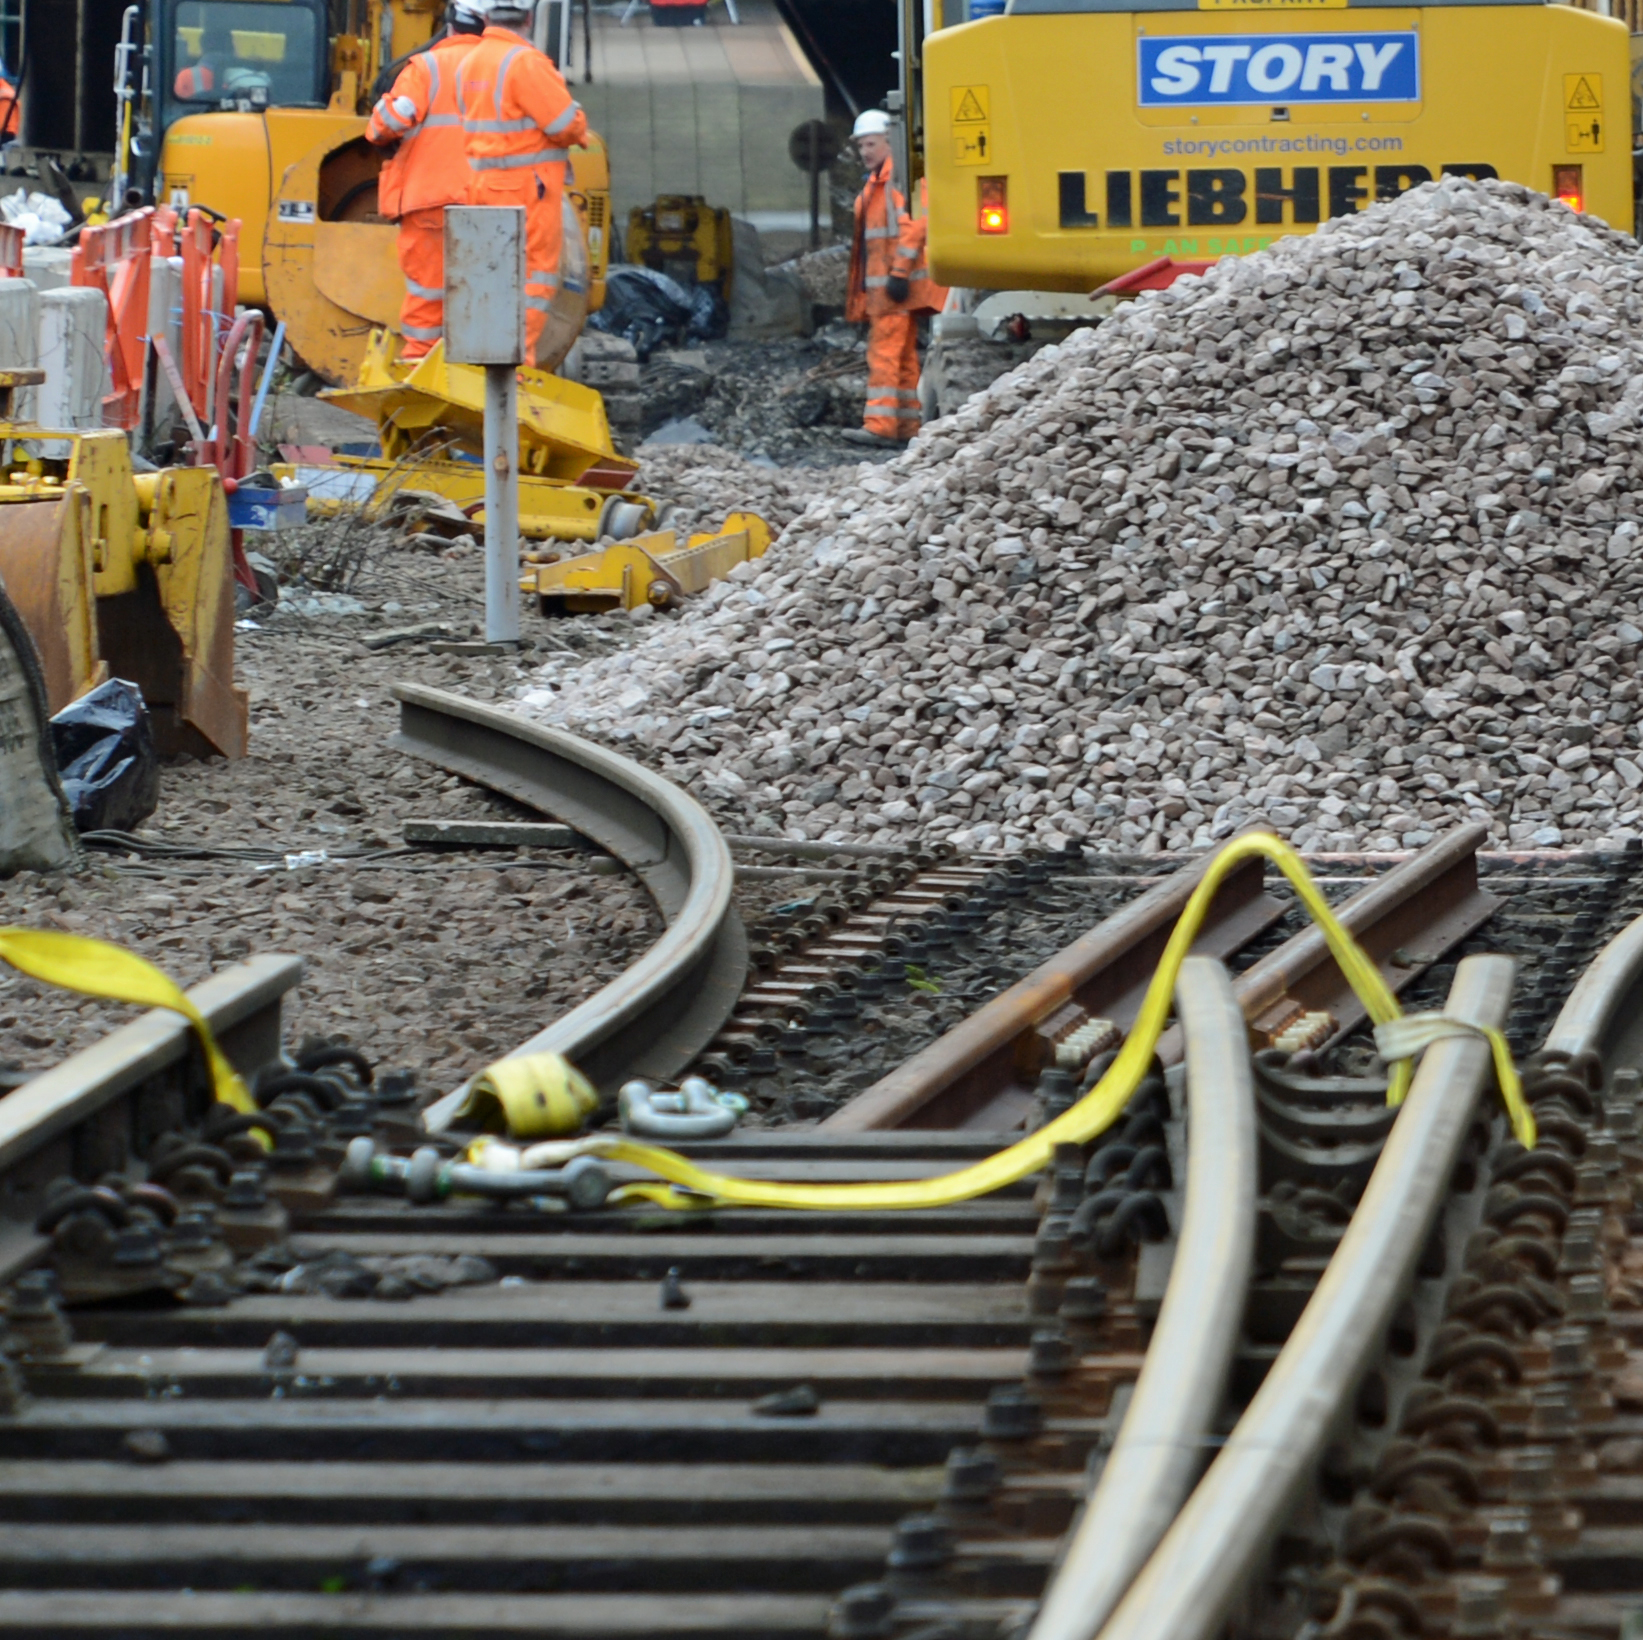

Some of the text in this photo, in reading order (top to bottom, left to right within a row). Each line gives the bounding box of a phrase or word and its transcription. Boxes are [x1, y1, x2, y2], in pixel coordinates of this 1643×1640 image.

[1150, 42, 1404, 95] STORY
[1163, 133, 1403, 158] storycontracting.com
[1130, 238, 1198, 256] PAN
